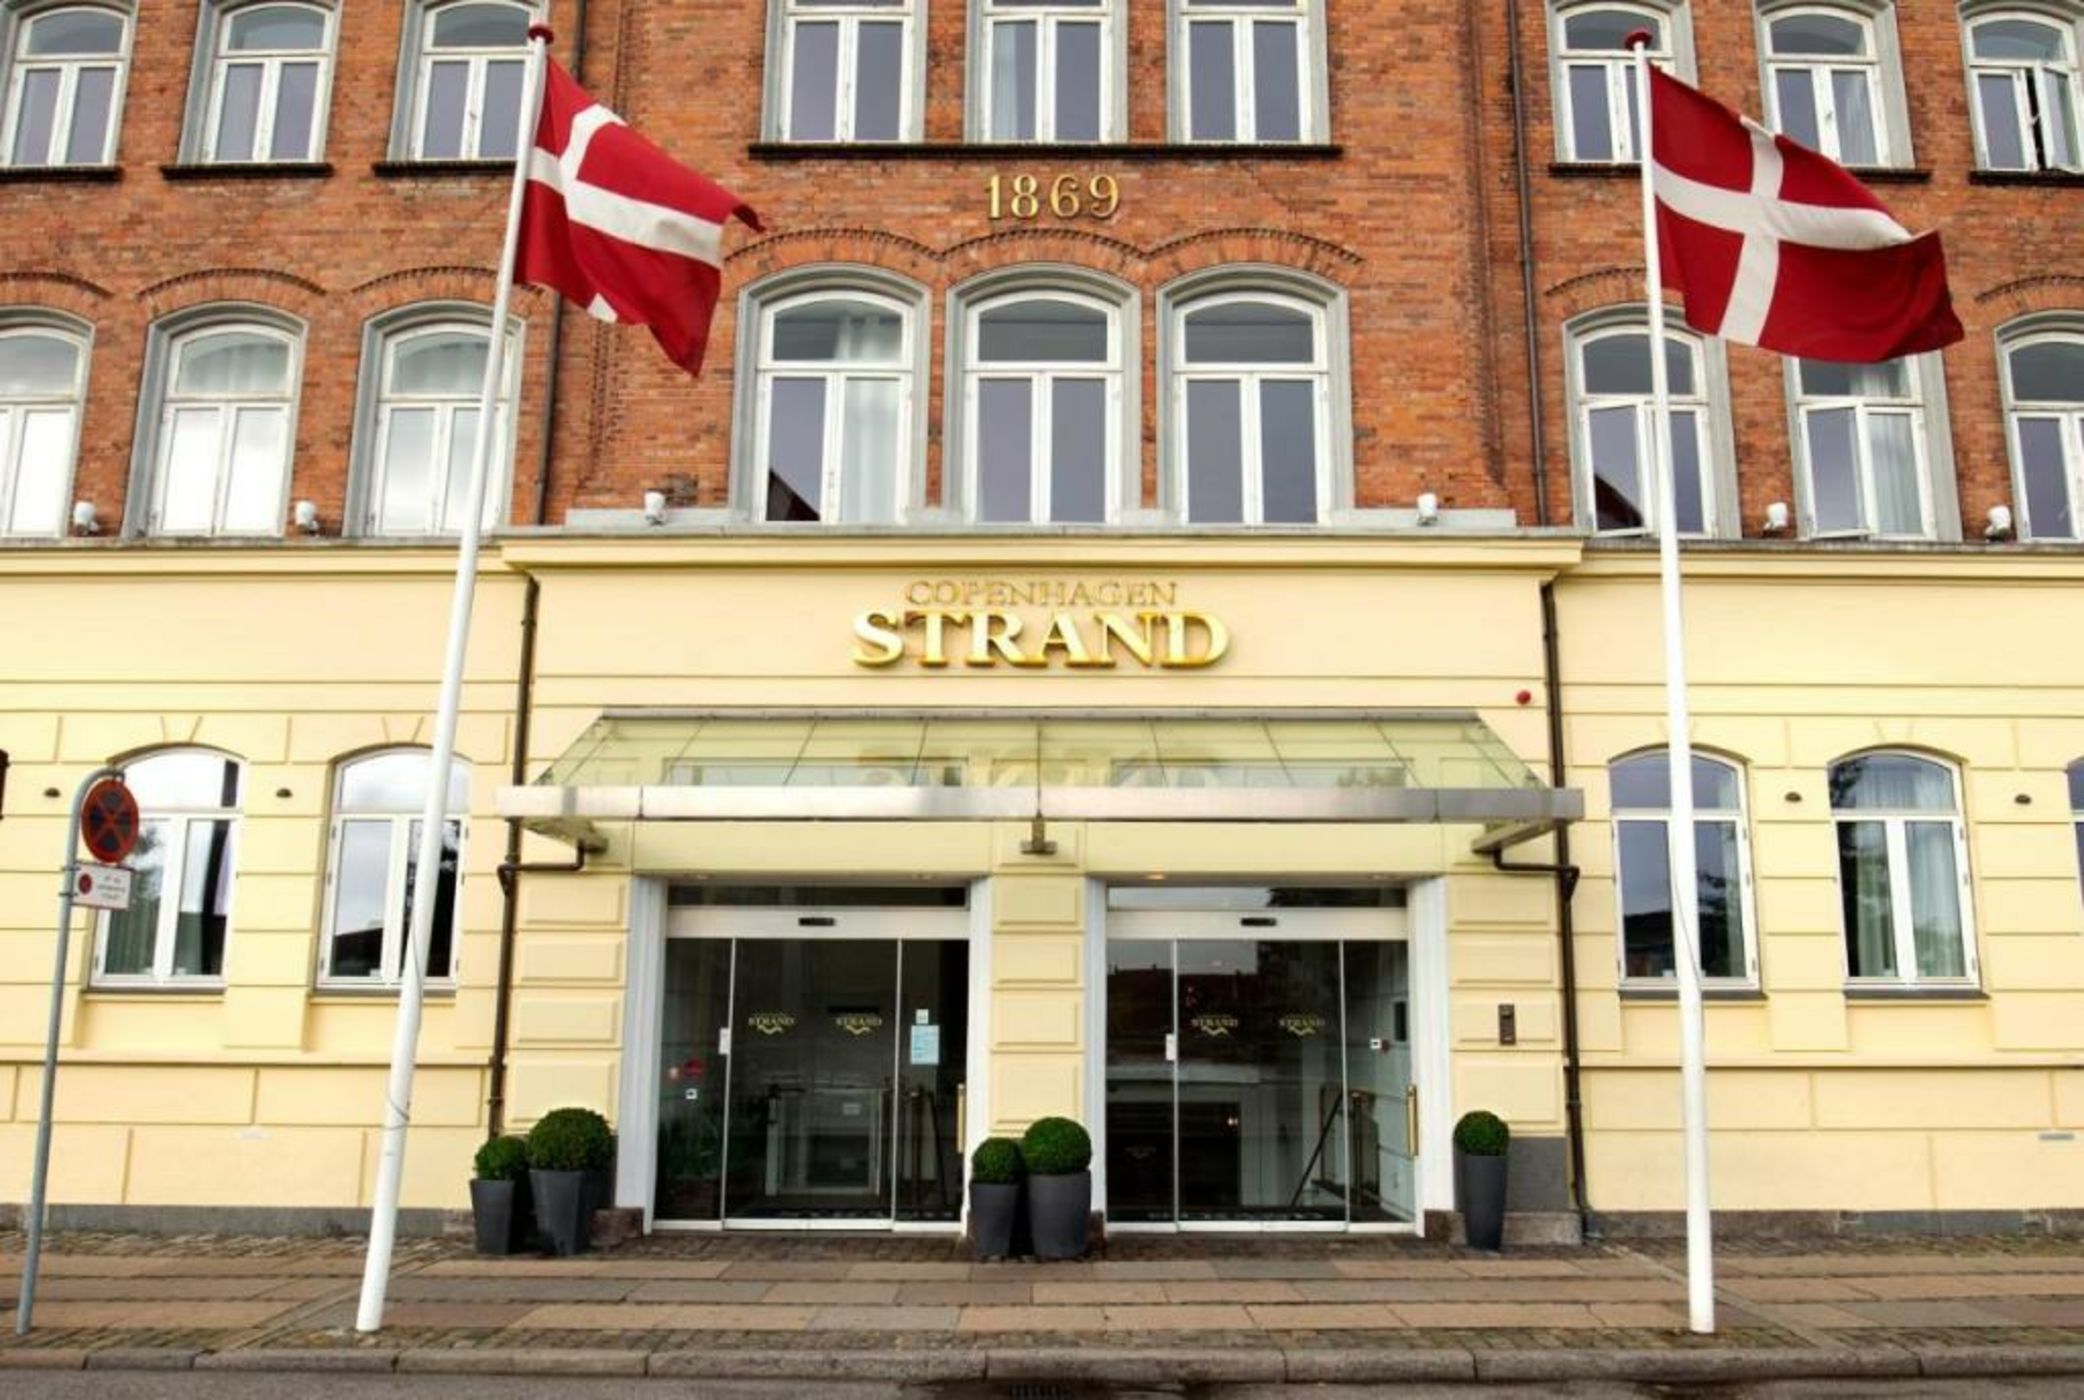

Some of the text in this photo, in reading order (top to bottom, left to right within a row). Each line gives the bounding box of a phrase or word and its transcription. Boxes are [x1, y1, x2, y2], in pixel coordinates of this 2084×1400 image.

[985, 173, 1119, 219] 1869
[905, 580, 1177, 606] COPENHAGEN
[852, 607, 1231, 669] STRAND
